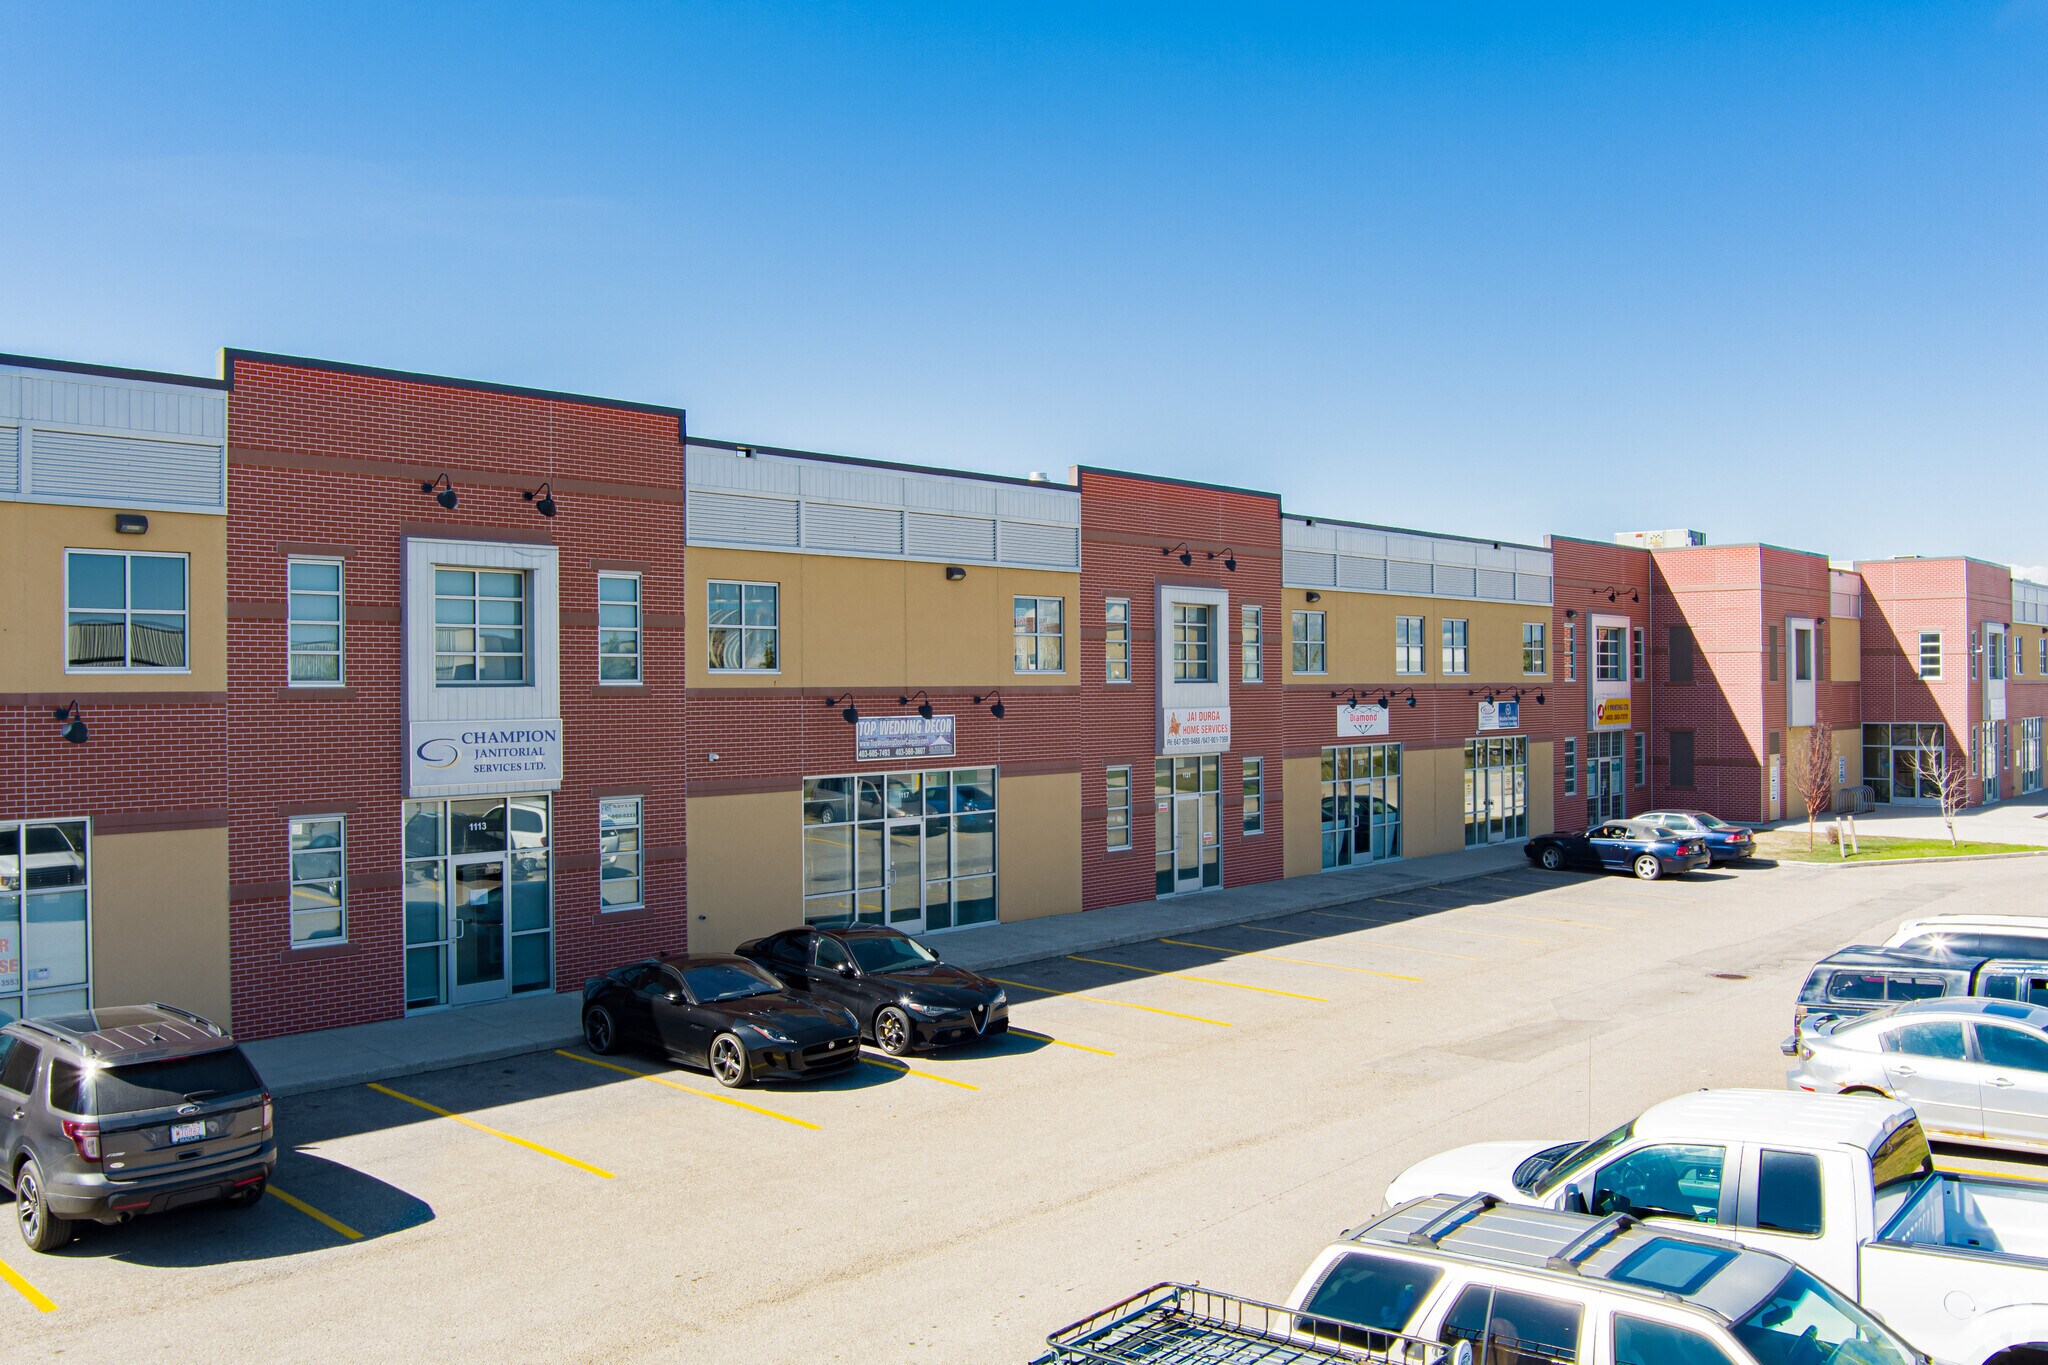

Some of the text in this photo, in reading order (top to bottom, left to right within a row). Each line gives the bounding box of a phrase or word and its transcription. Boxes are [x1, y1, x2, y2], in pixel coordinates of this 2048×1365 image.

[1187, 711, 1220, 722] JAI DURGA
[1350, 713, 1378, 721] Diamond
[859, 718, 952, 736] TOP WEDDING DECOR
[1182, 724, 1229, 734] HOME SERVICES
[461, 730, 556, 744] CHAMPION
[474, 747, 545, 760] JANITORIAL
[473, 762, 546, 773] SERVICES LTD.
[469, 822, 487, 830] 1113
